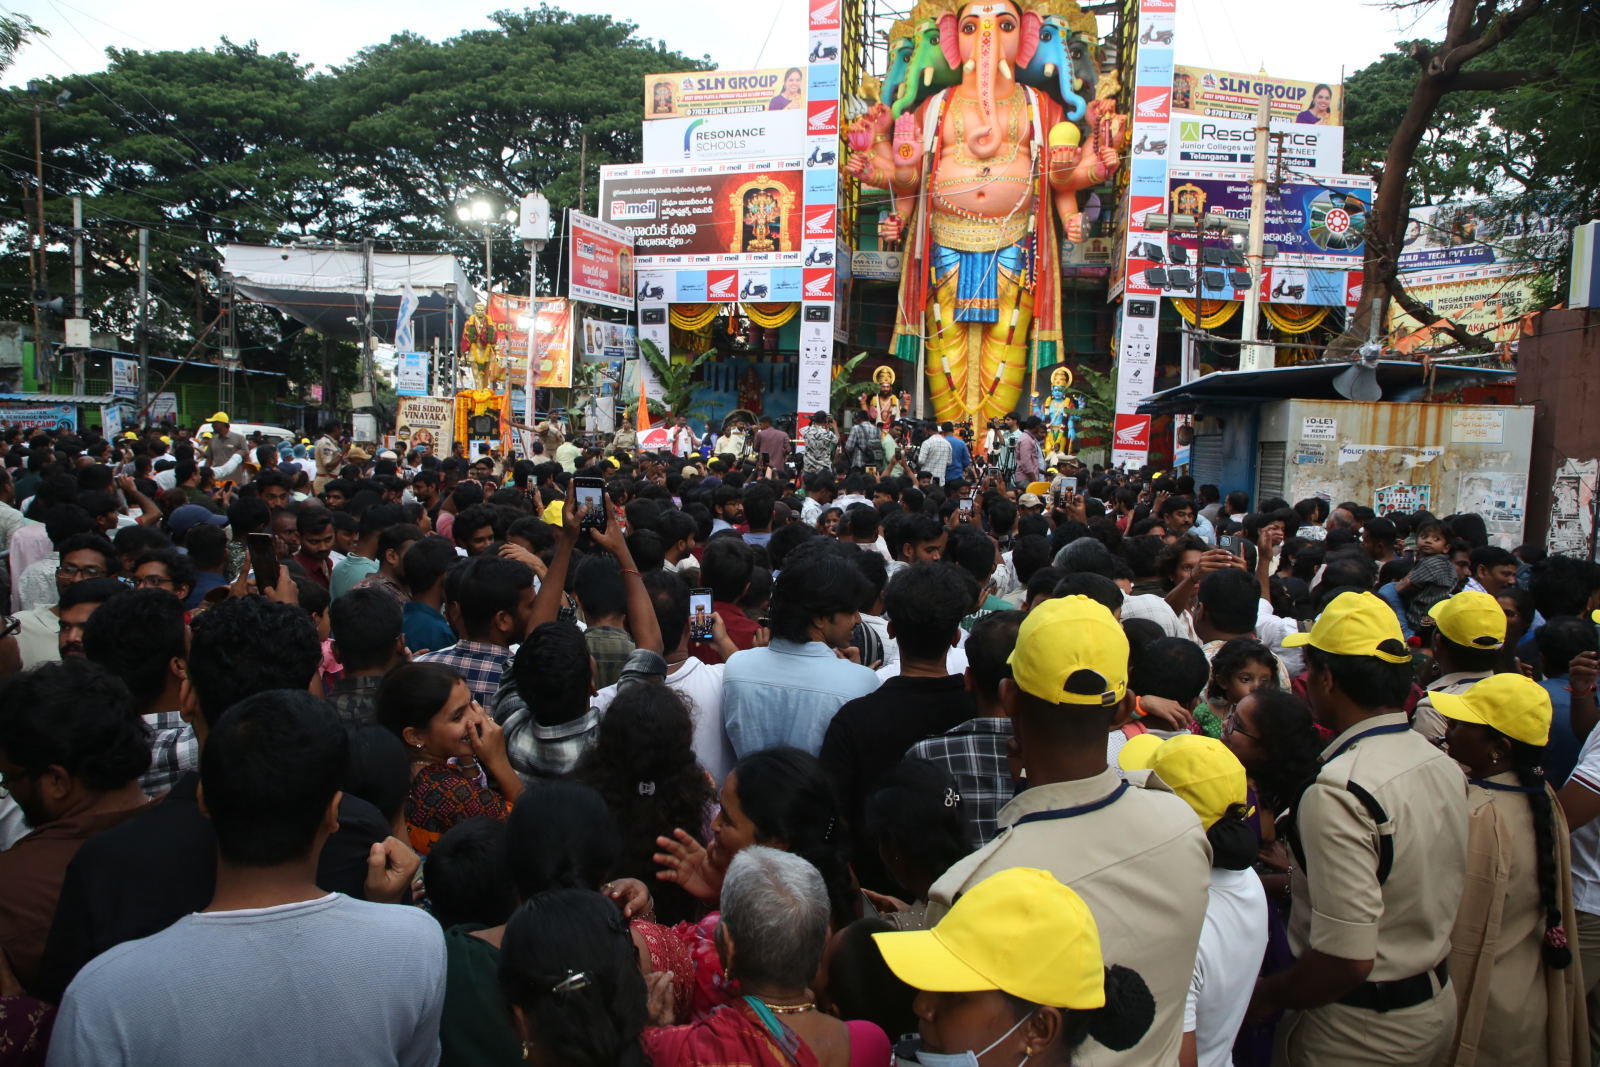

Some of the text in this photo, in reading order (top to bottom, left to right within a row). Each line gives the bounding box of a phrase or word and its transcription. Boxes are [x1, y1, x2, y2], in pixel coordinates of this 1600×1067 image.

[698, 74, 778, 91] SLN GROUP
[1219, 77, 1307, 100] SLN GROUP
[697, 127, 766, 140] RESONANCE
[1202, 124, 1318, 146] Resoance
[696, 140, 746, 152] SCHOOLS
[1180, 142, 1204, 150] Junior
[1207, 143, 1241, 152] Colleges
[1296, 147, 1316, 155] NEET
[1189, 152, 1229, 162] Telangana
[1281, 157, 1310, 166] Pradesh
[627, 200, 656, 214] meil
[1225, 209, 1249, 219] meil
[1428, 252, 1446, 260] TECH
[1438, 296, 1463, 304] MEGHA
[1464, 291, 1515, 302] ENGINEING
[408, 404, 444, 413] SRI SIDDI
[405, 411, 447, 422] VINAYAKA
[37, 420, 57, 428] CAMP
[1116, 438, 1146, 446] HONDA
